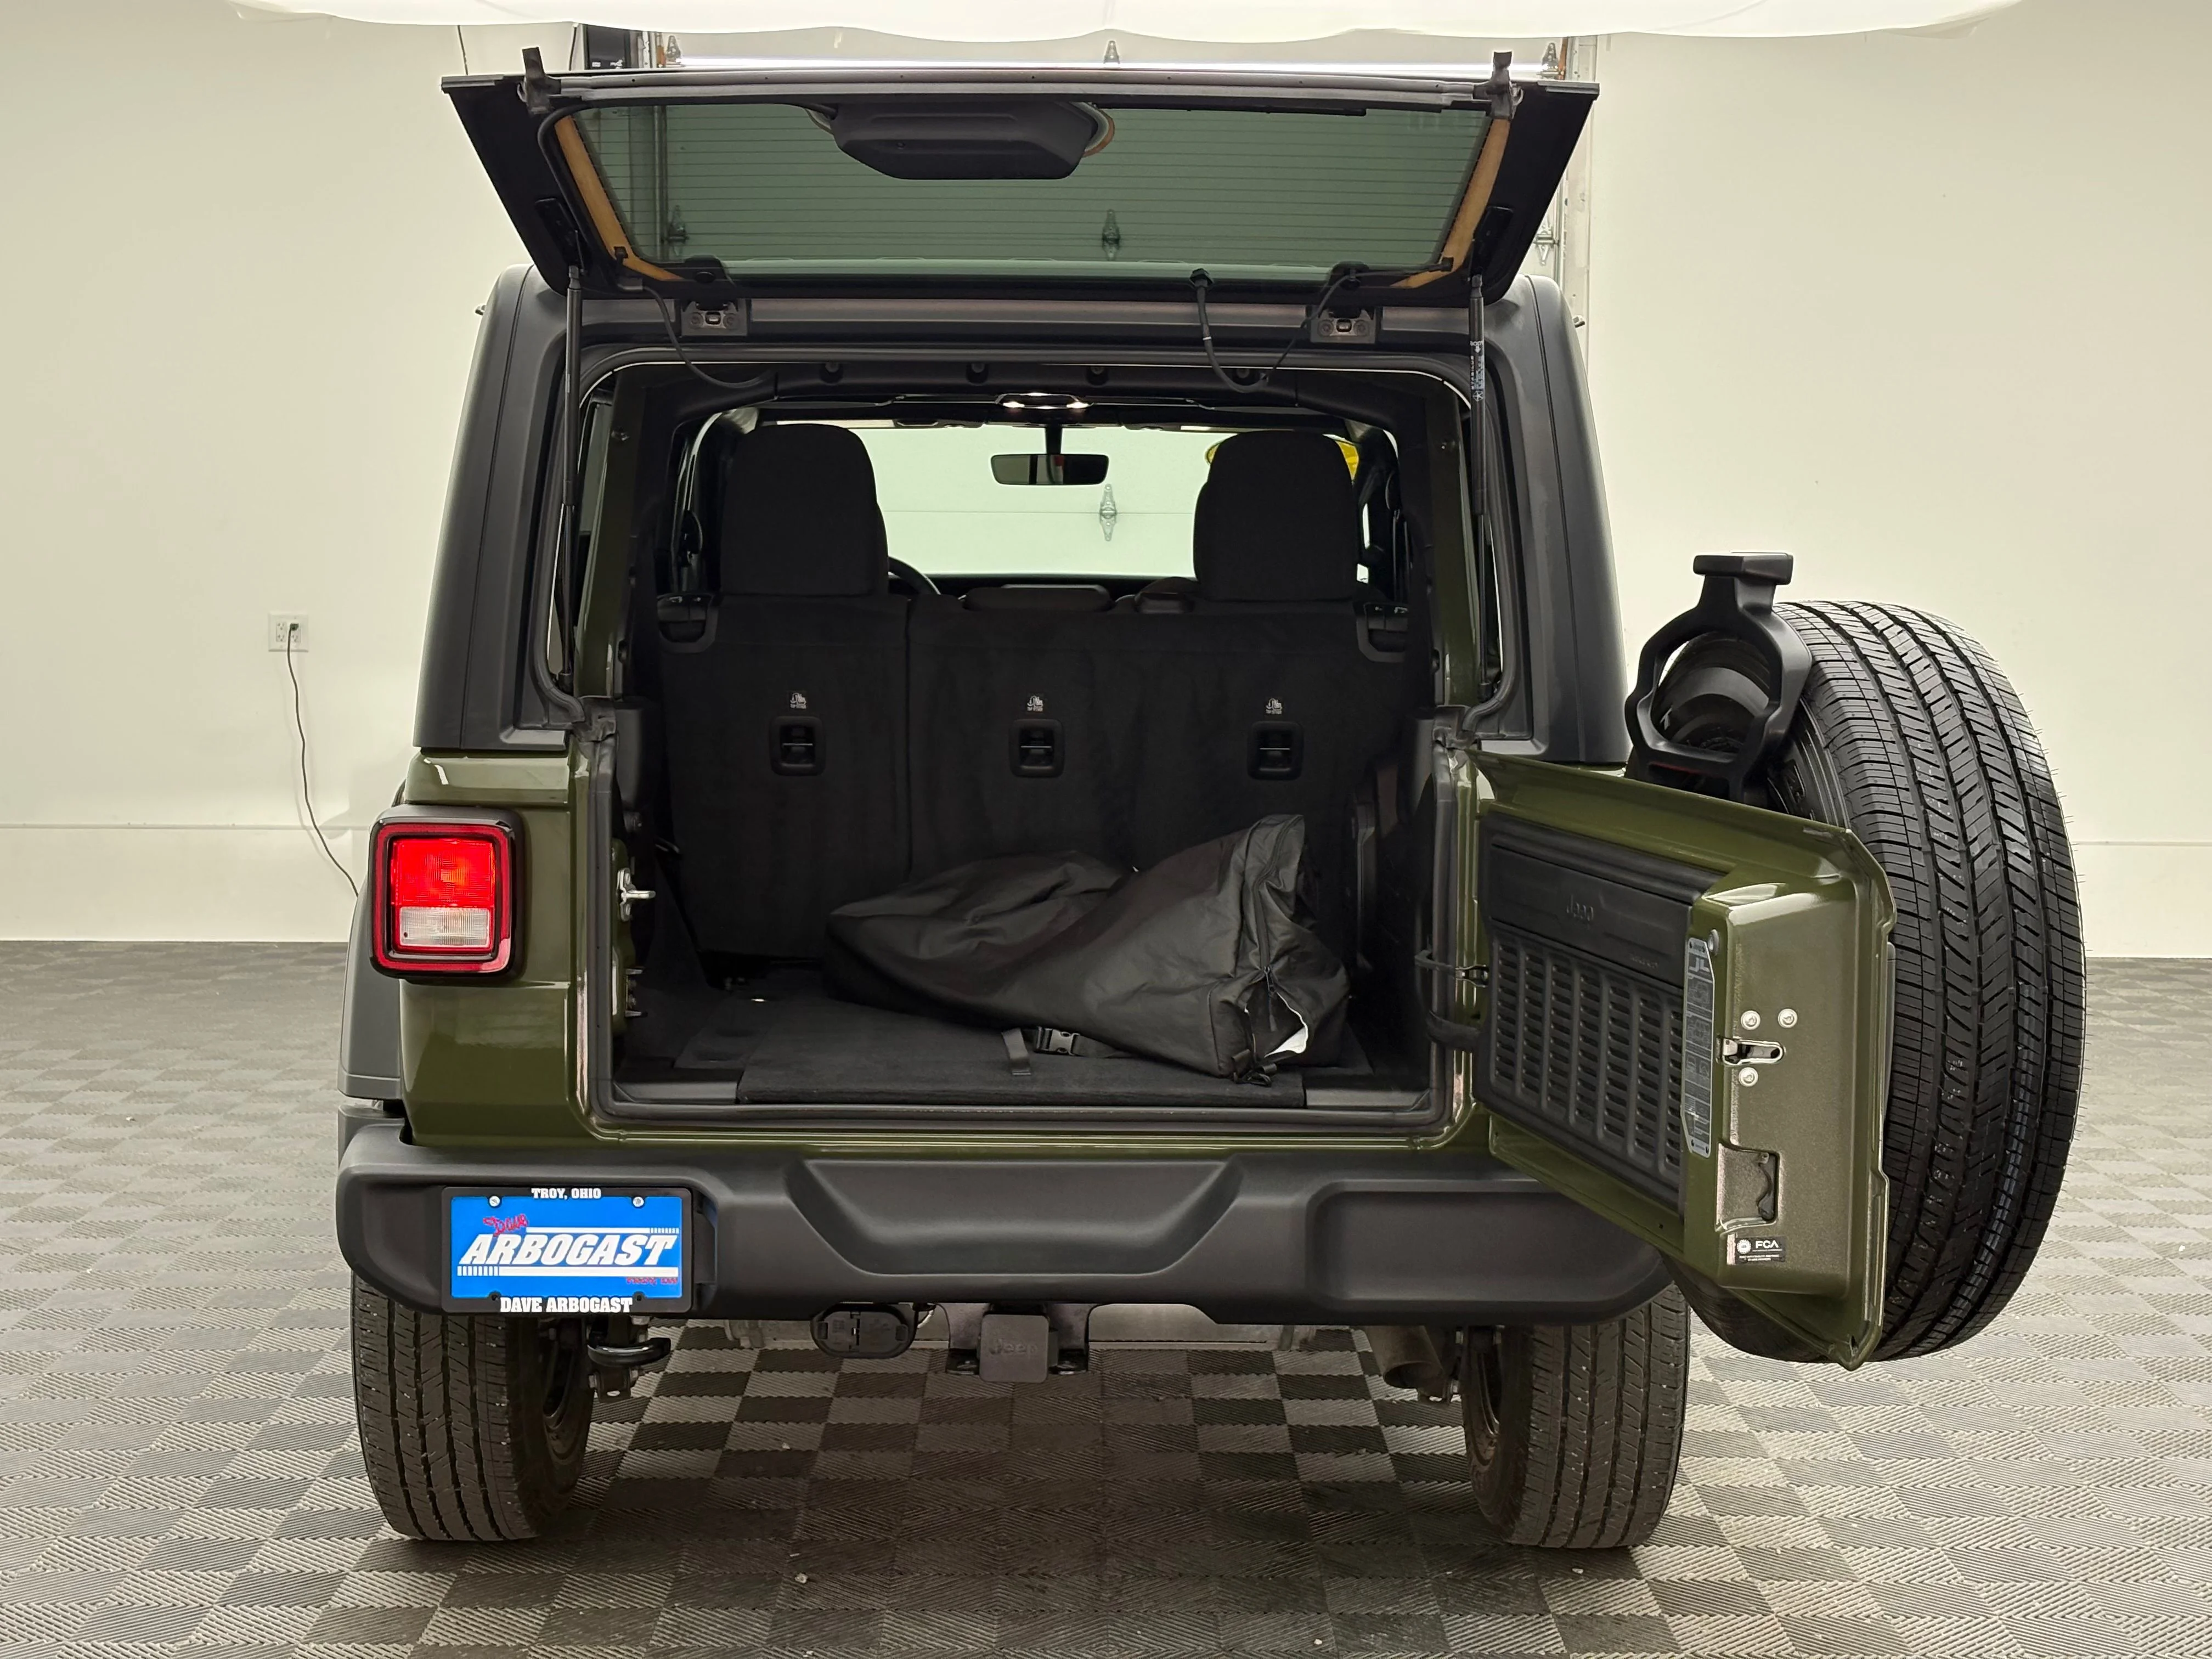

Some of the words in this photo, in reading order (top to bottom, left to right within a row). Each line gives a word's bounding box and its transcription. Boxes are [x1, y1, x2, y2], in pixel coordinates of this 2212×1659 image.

[1689, 957, 1711, 973] JL
[531, 1188, 568, 1200] TROY,
[571, 1188, 601, 1199] OHIO
[483, 1214, 529, 1236] Dave
[459, 1234, 678, 1265] ARBOGAST
[1756, 1240, 1779, 1249] FCA
[500, 1297, 543, 1313] DAVE
[546, 1297, 633, 1313] ARBOGAST
